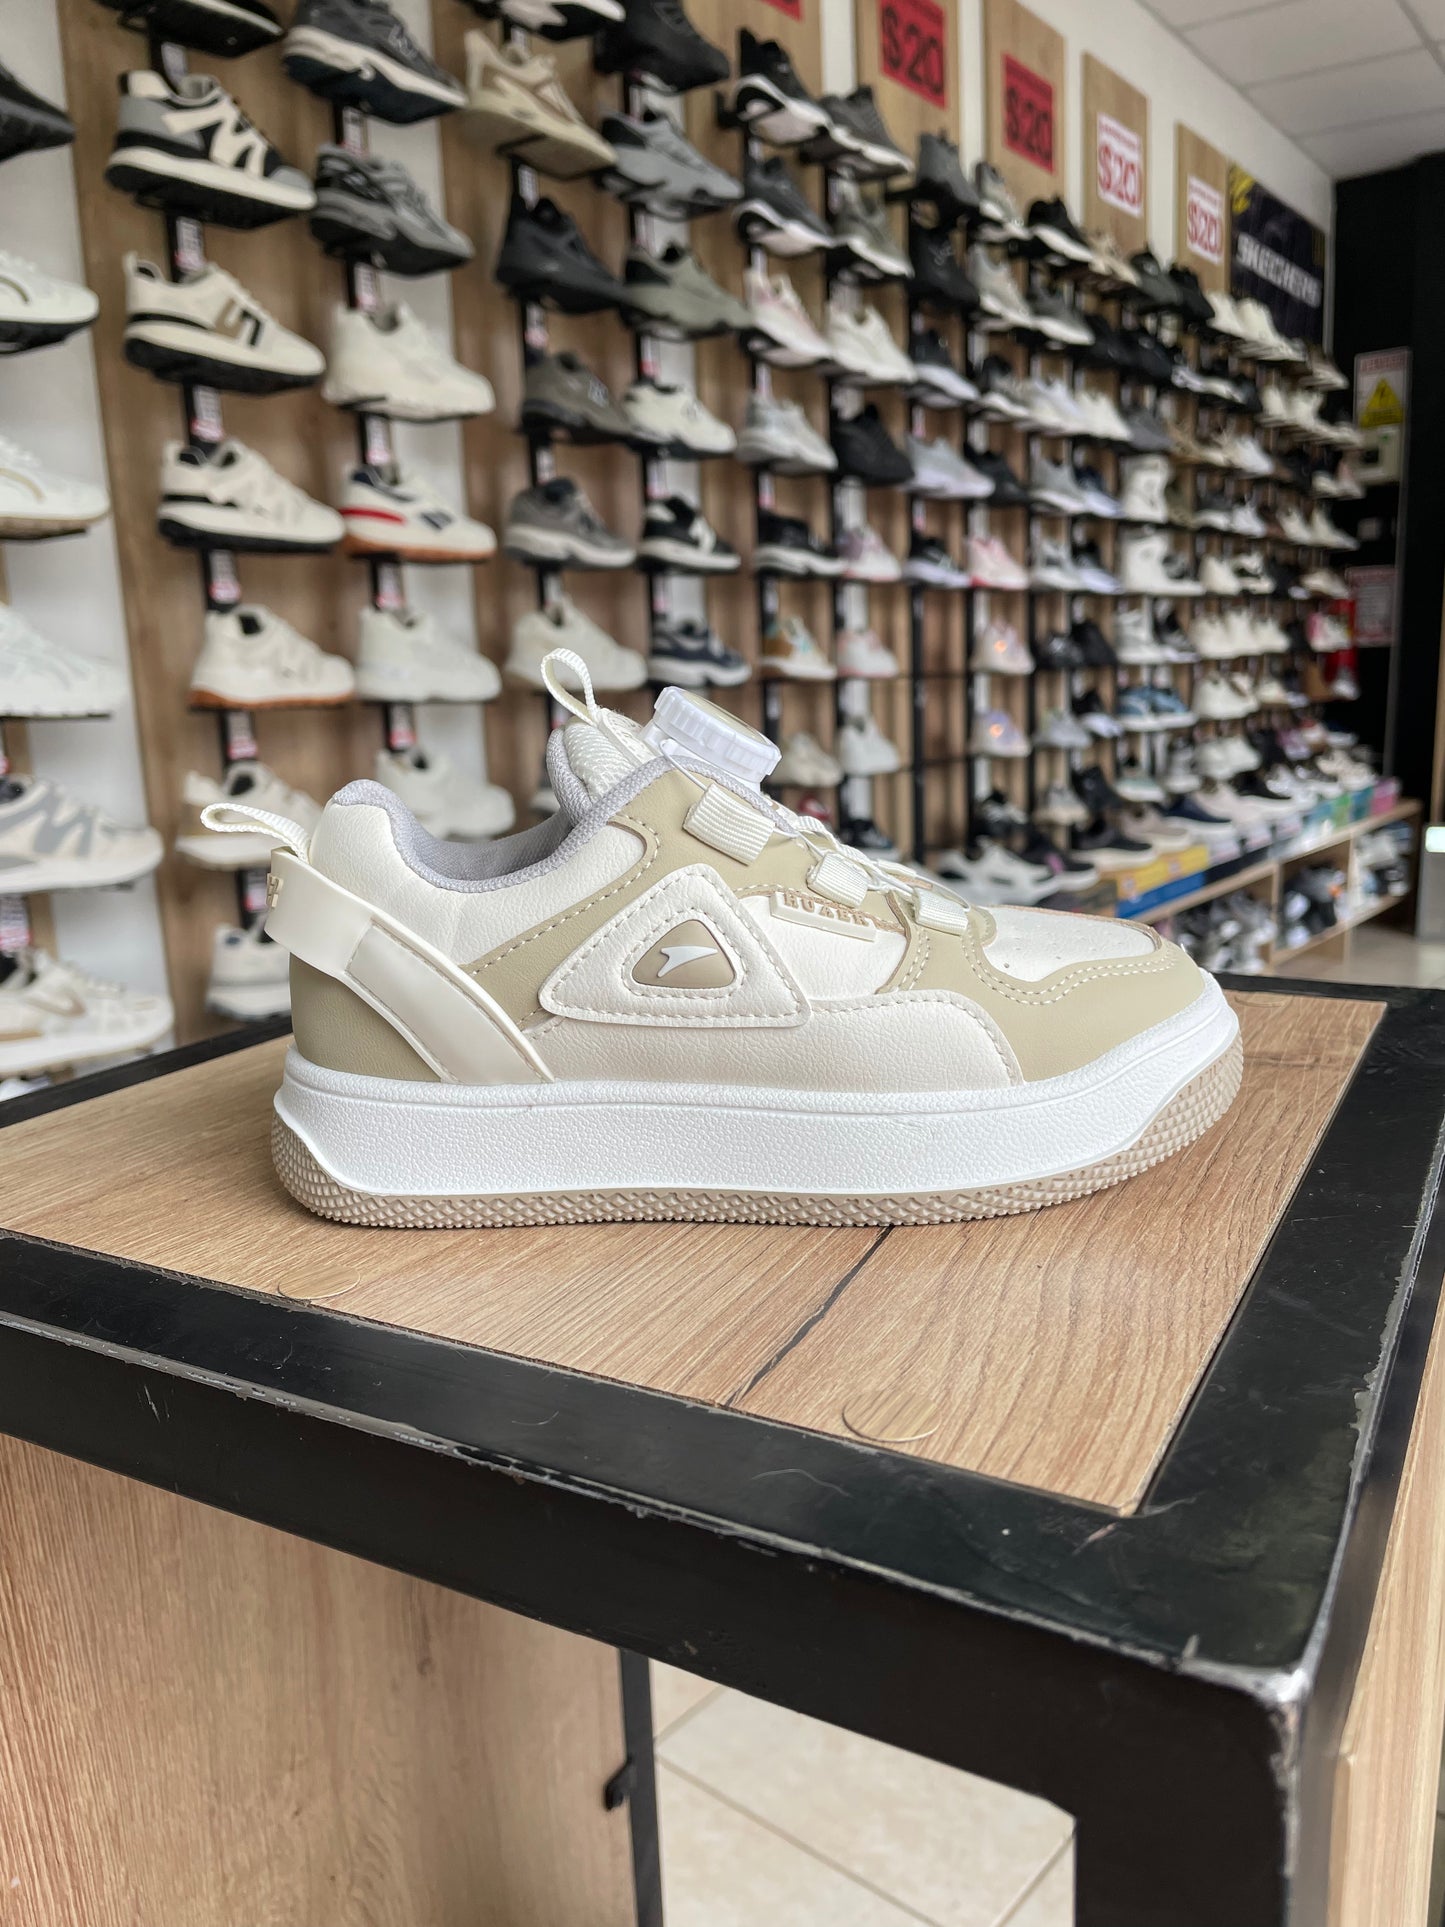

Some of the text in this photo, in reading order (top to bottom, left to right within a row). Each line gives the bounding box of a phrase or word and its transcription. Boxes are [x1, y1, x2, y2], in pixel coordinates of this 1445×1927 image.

[881, 5, 946, 95] $20
[1006, 85, 1054, 162] $20
[1099, 143, 1142, 206] $20
[1187, 201, 1221, 256] $20
